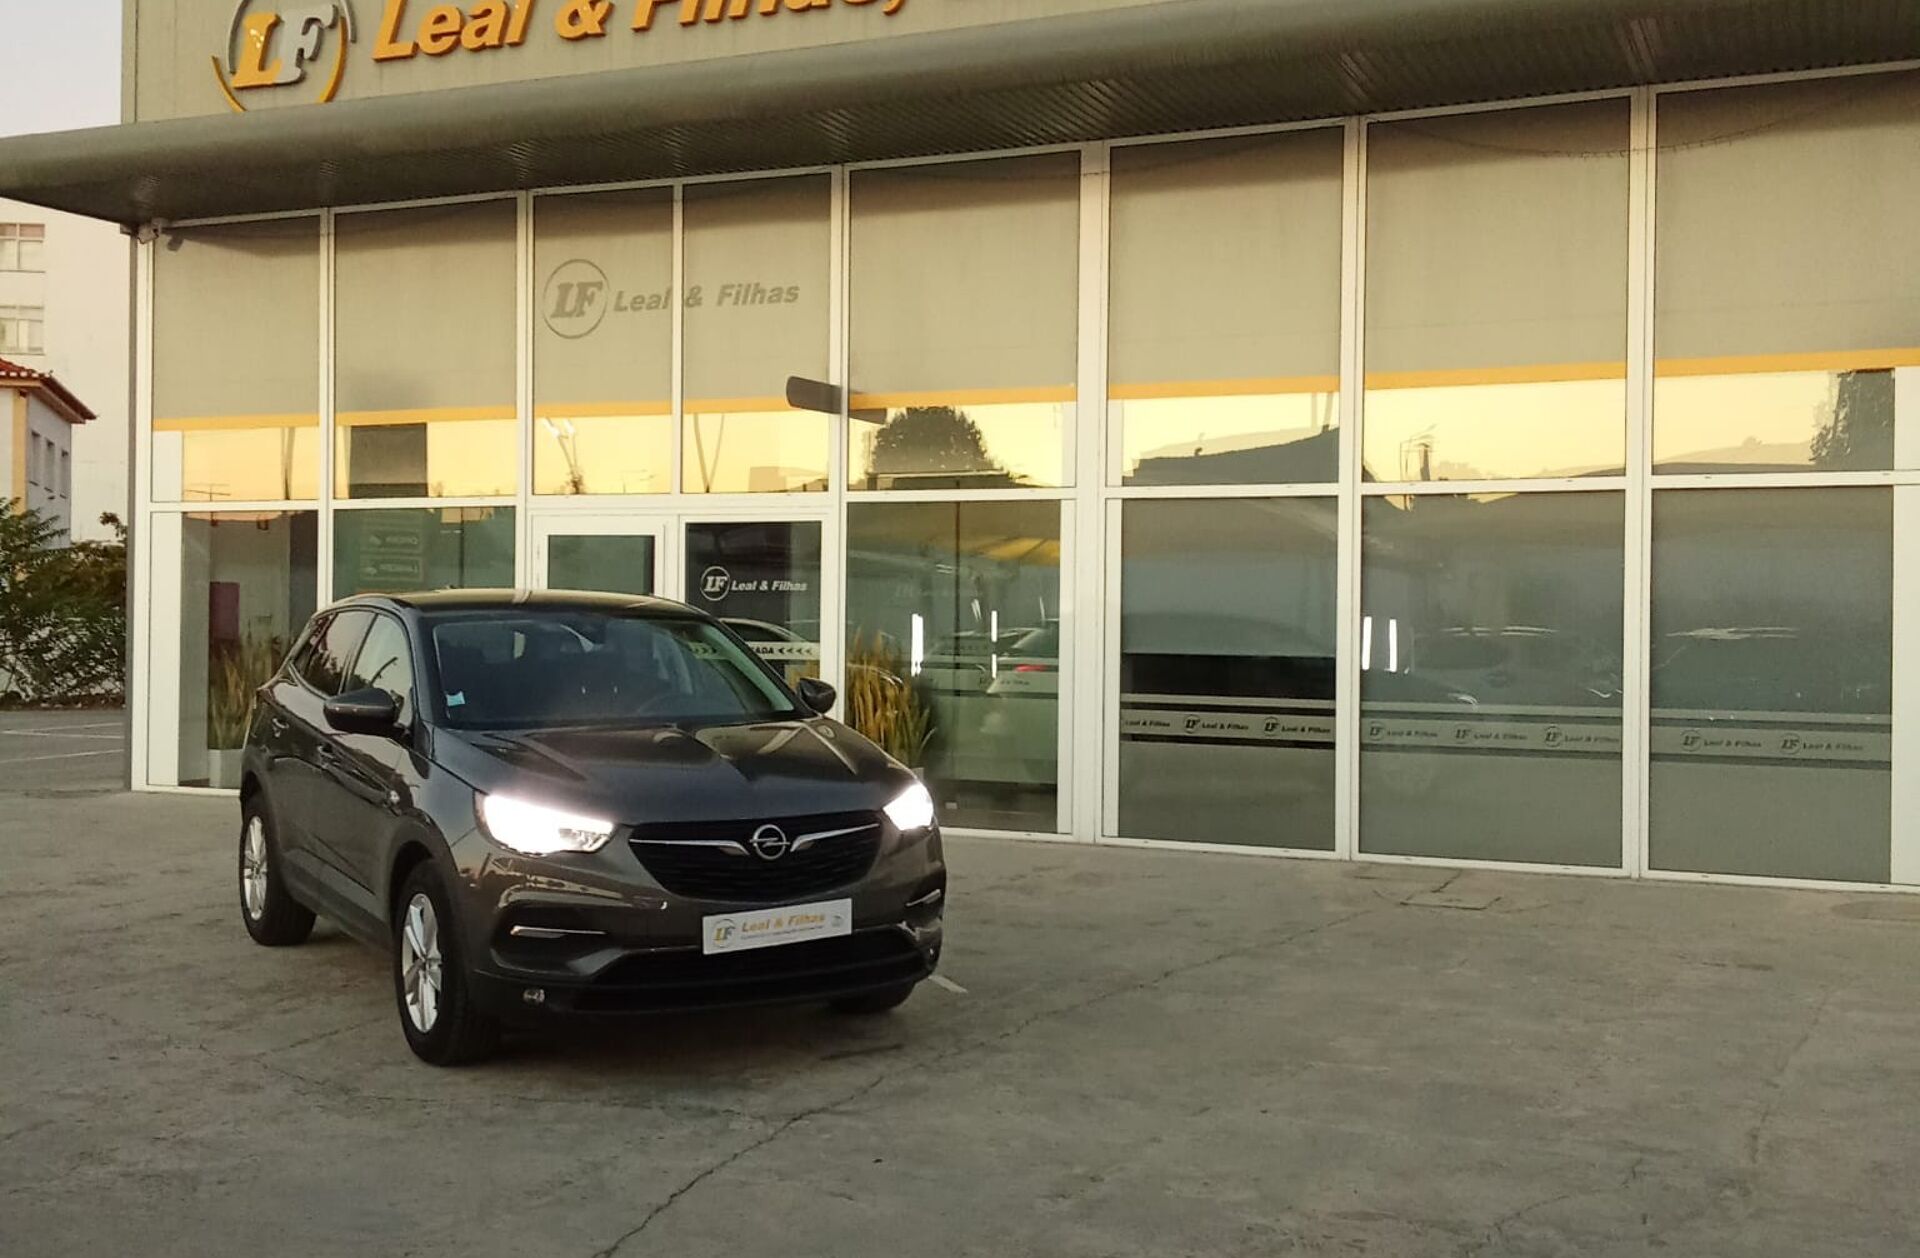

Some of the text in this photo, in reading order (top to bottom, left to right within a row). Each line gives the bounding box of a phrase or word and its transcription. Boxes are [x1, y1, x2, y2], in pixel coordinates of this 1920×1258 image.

[232, 3, 338, 89] LF
[371, 0, 533, 62] Leal
[555, 0, 614, 40] &
[550, 281, 800, 318] LF Leal & Filhas
[704, 575, 808, 592] LF Leal & Filhas
[741, 919, 770, 933] Leal
